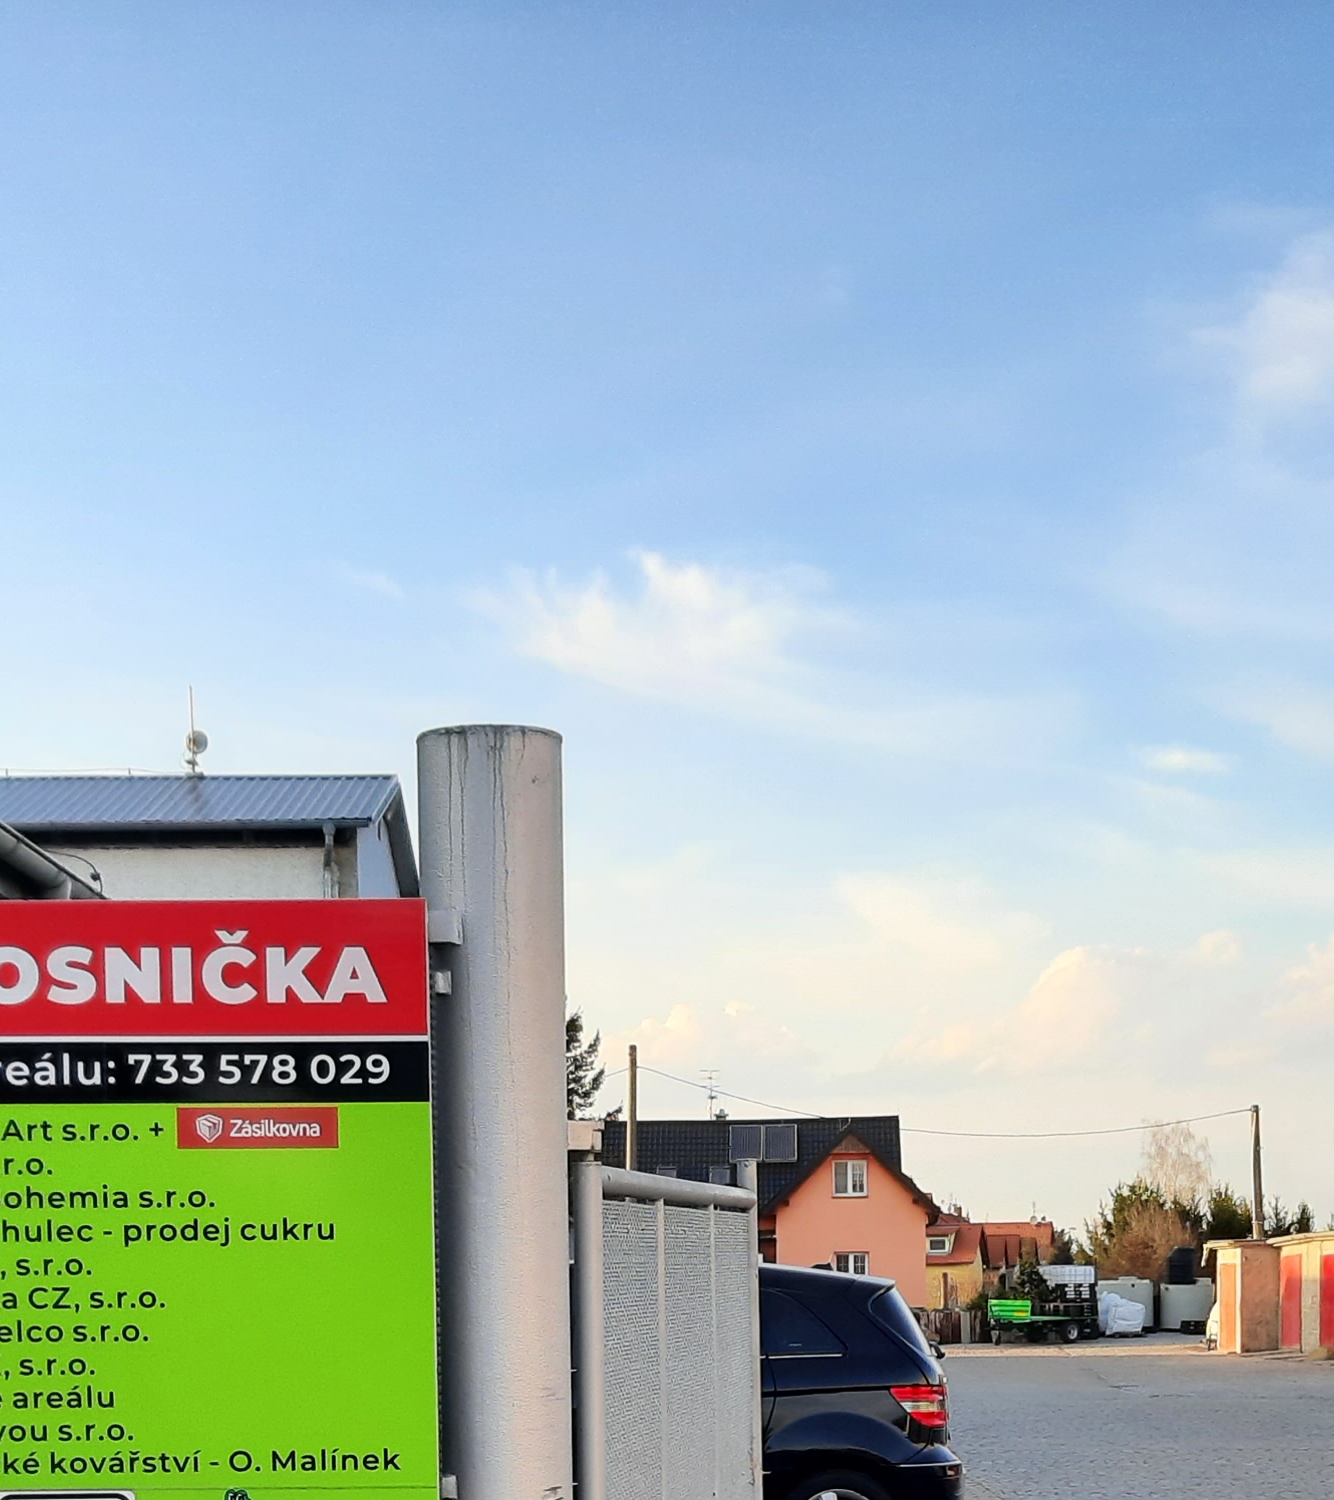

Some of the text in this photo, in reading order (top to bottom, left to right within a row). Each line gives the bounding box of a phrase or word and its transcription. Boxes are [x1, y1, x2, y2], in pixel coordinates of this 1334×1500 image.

[127, 1053, 206, 1085] 733
[217, 1053, 297, 1085] 578
[310, 1053, 391, 1085] 029
[1, 1119, 53, 1142] Art
[62, 1123, 139, 1142] s.r.o.
[229, 1119, 322, 1138] Zásilkovna
[138, 1190, 215, 1209] s.r.o.
[123, 1217, 230, 1248] prodej
[240, 1217, 335, 1241] cukru
[15, 1258, 92, 1277] s.r.o.
[28, 1286, 80, 1313] CZ,
[89, 1291, 166, 1309] s.r.o.
[72, 1324, 149, 1343] s.r.o.
[19, 1358, 96, 1377] s.r.o.
[12, 1385, 115, 1410] areálu
[58, 1423, 134, 1442] s.r.o.
[50, 1449, 201, 1474] kovářství
[228, 1450, 261, 1473] O.
[271, 1448, 401, 1472] Malínek
